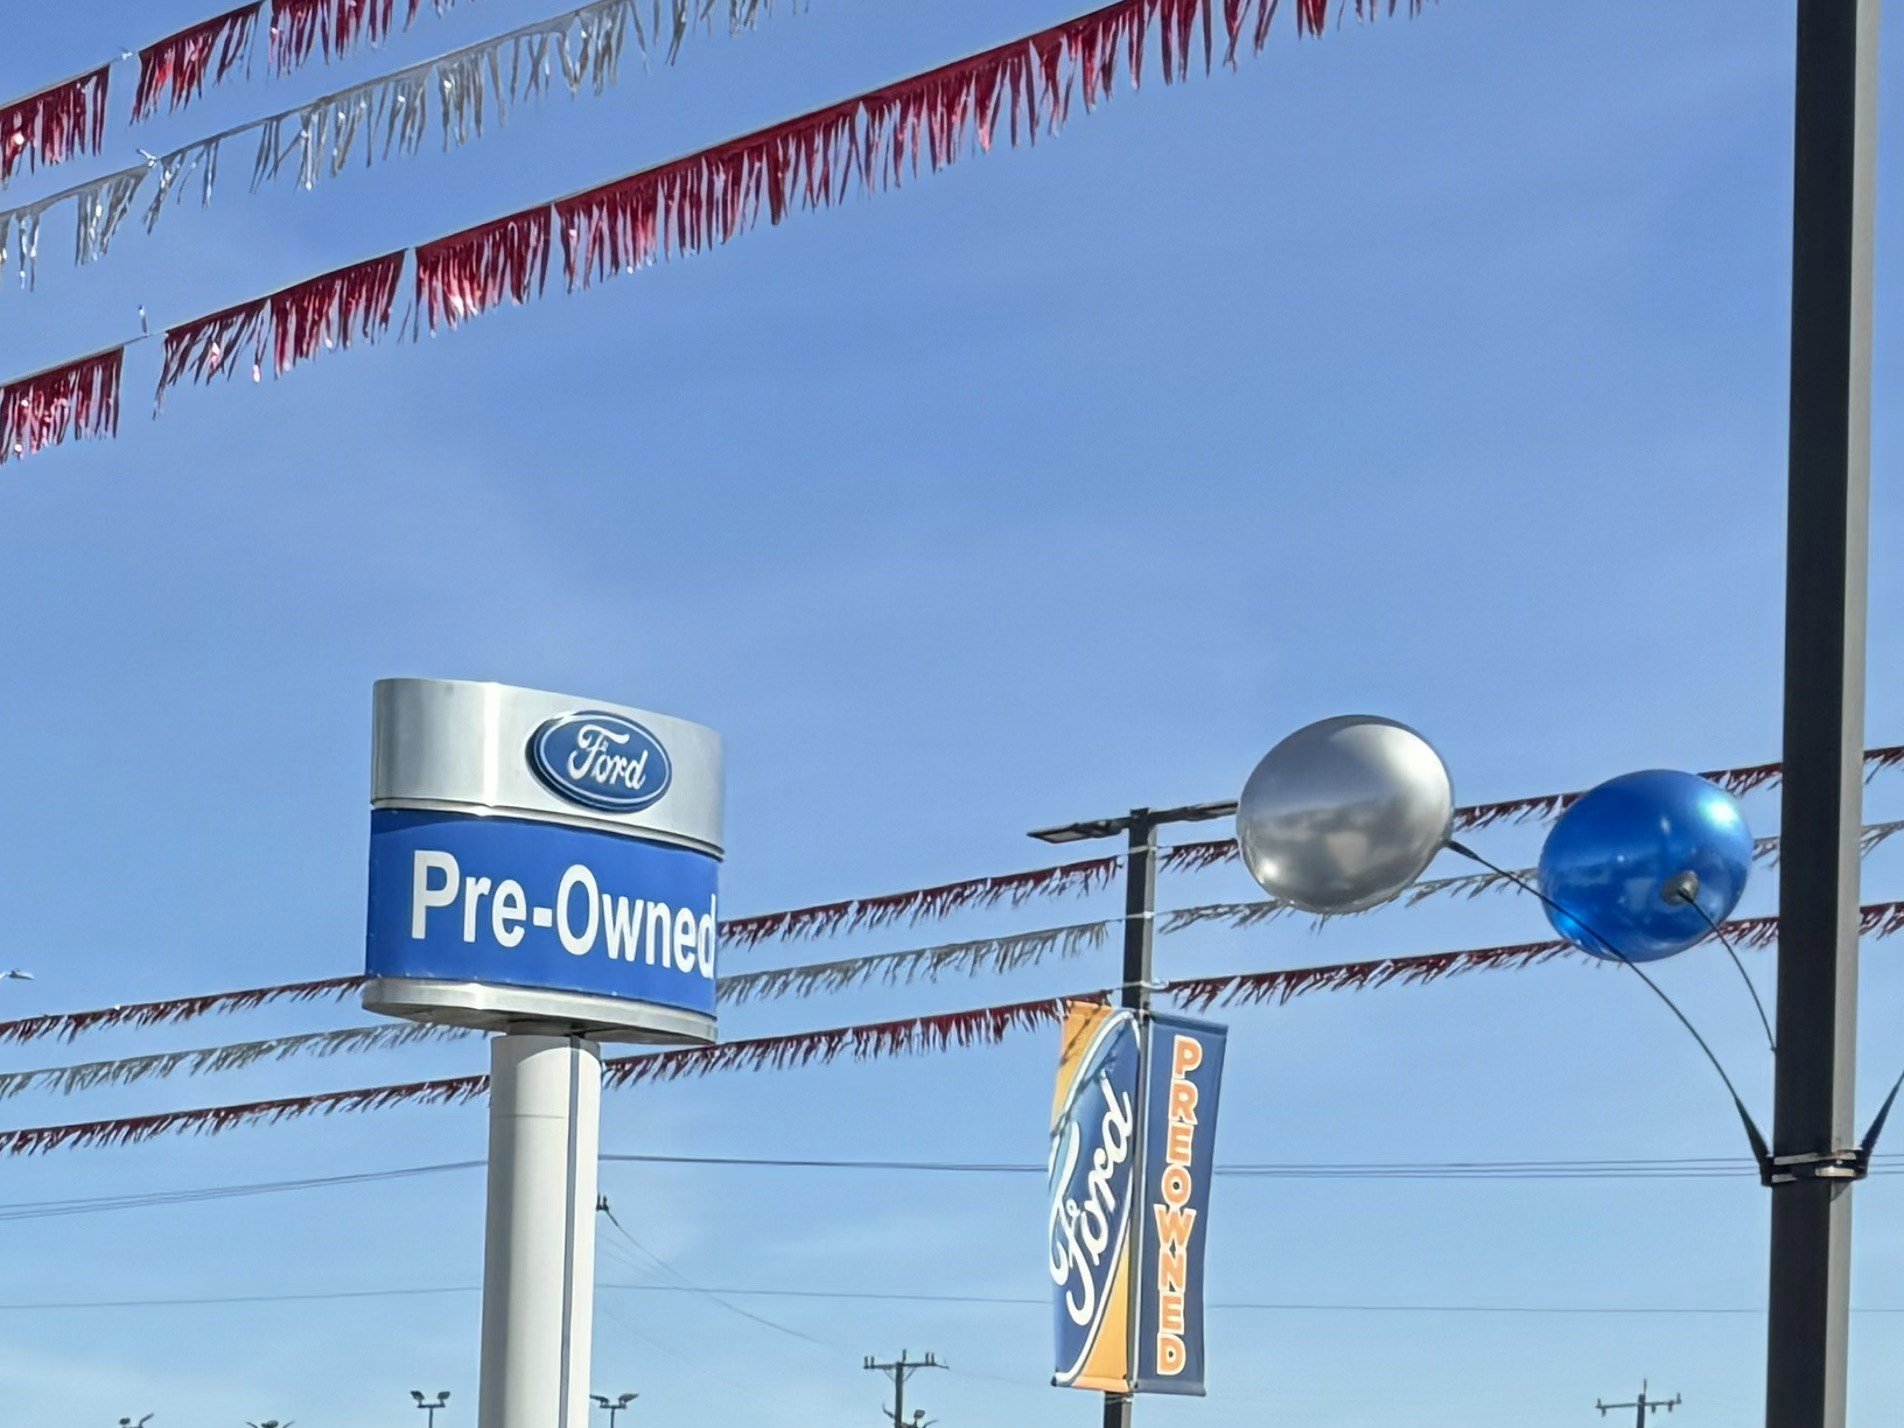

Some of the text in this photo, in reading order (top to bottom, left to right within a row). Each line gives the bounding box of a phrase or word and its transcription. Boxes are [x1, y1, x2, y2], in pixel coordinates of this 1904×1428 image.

[566, 723, 649, 791] Ford
[410, 848, 717, 980] Pre-Owned
[1048, 1066, 1134, 1327] Ford
[1153, 1034, 1203, 1376] PREOWNED
